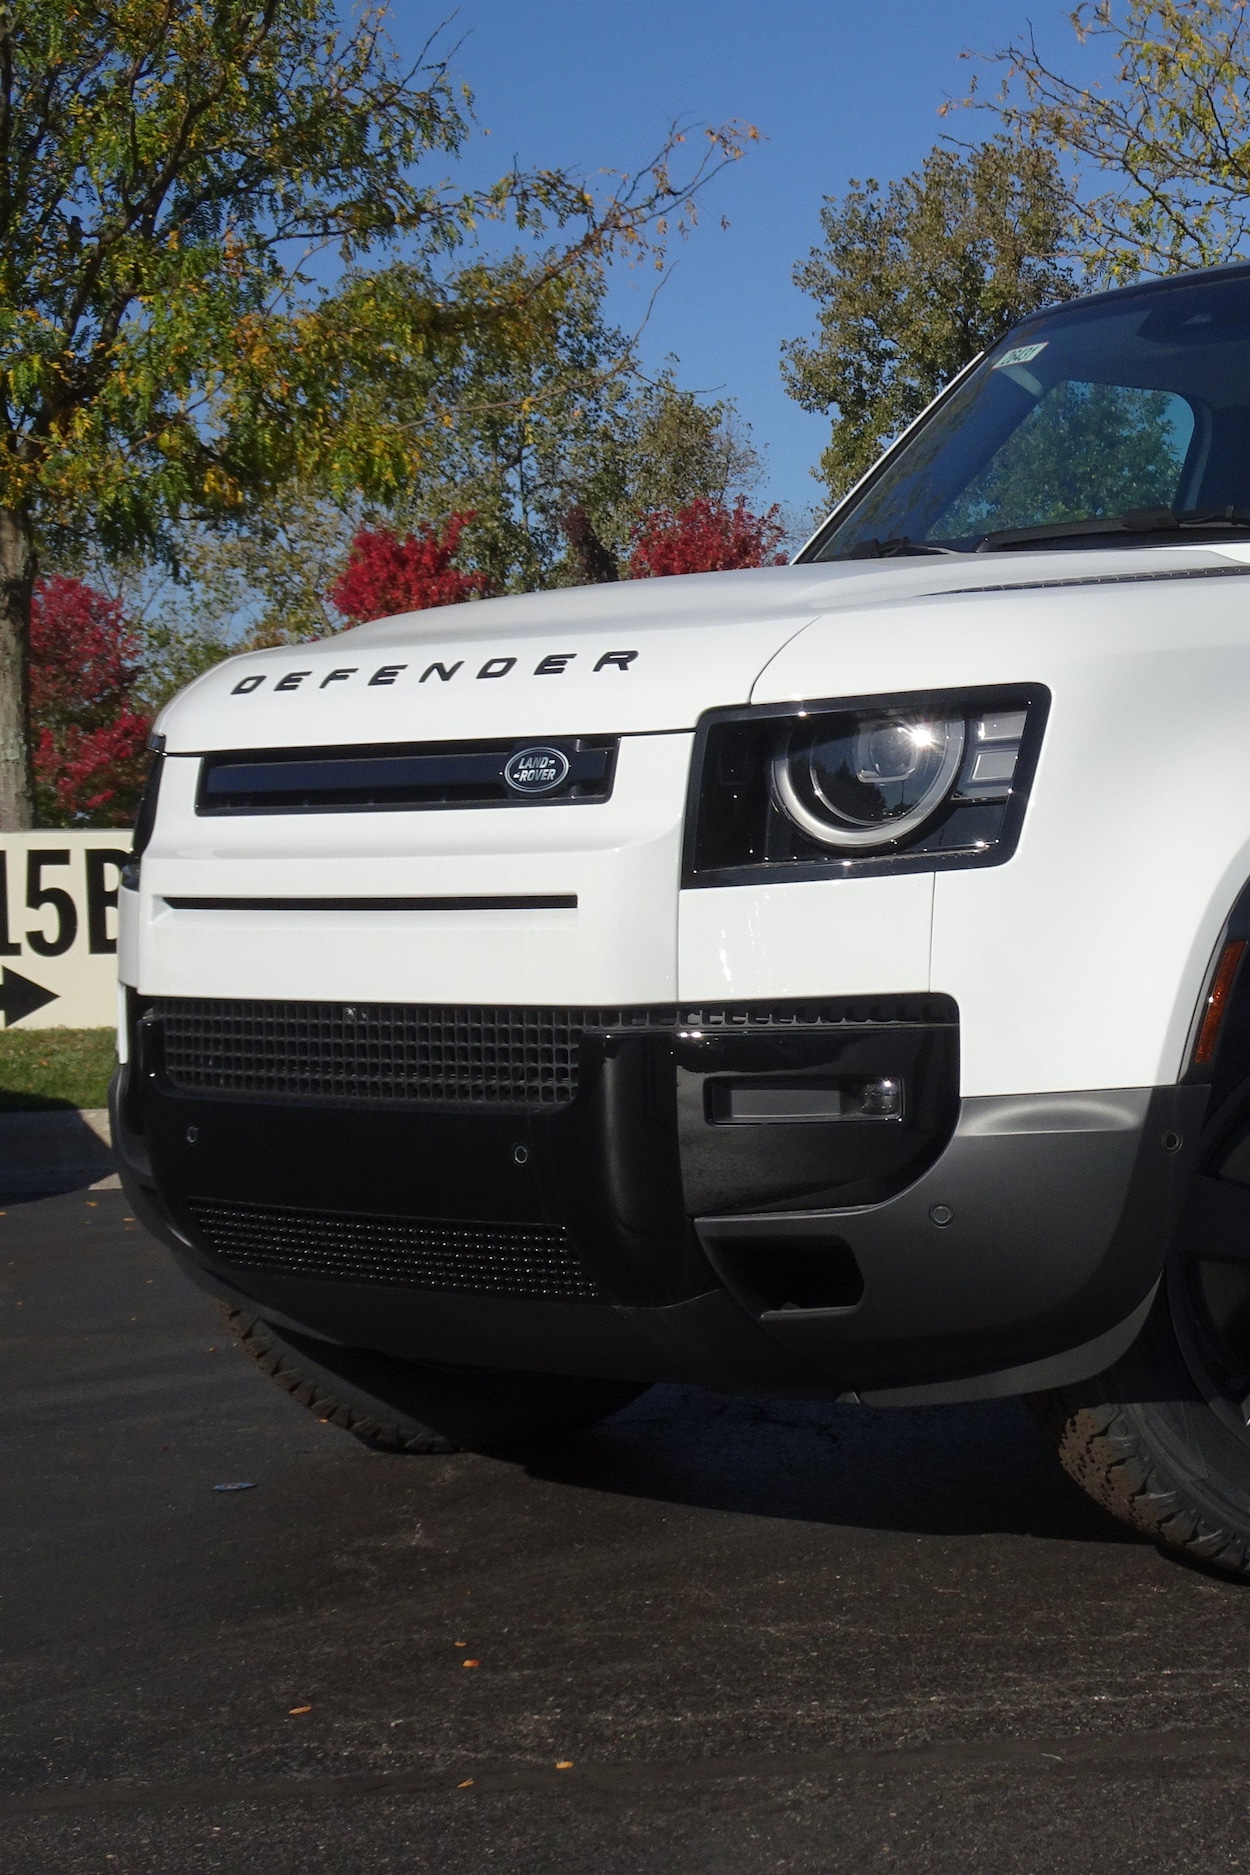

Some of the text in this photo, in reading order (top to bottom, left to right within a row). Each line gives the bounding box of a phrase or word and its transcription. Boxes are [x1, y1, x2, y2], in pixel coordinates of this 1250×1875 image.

[230, 650, 639, 695] DEFENDER
[518, 756, 549, 769] LAND
[518, 768, 556, 781] ROVER
